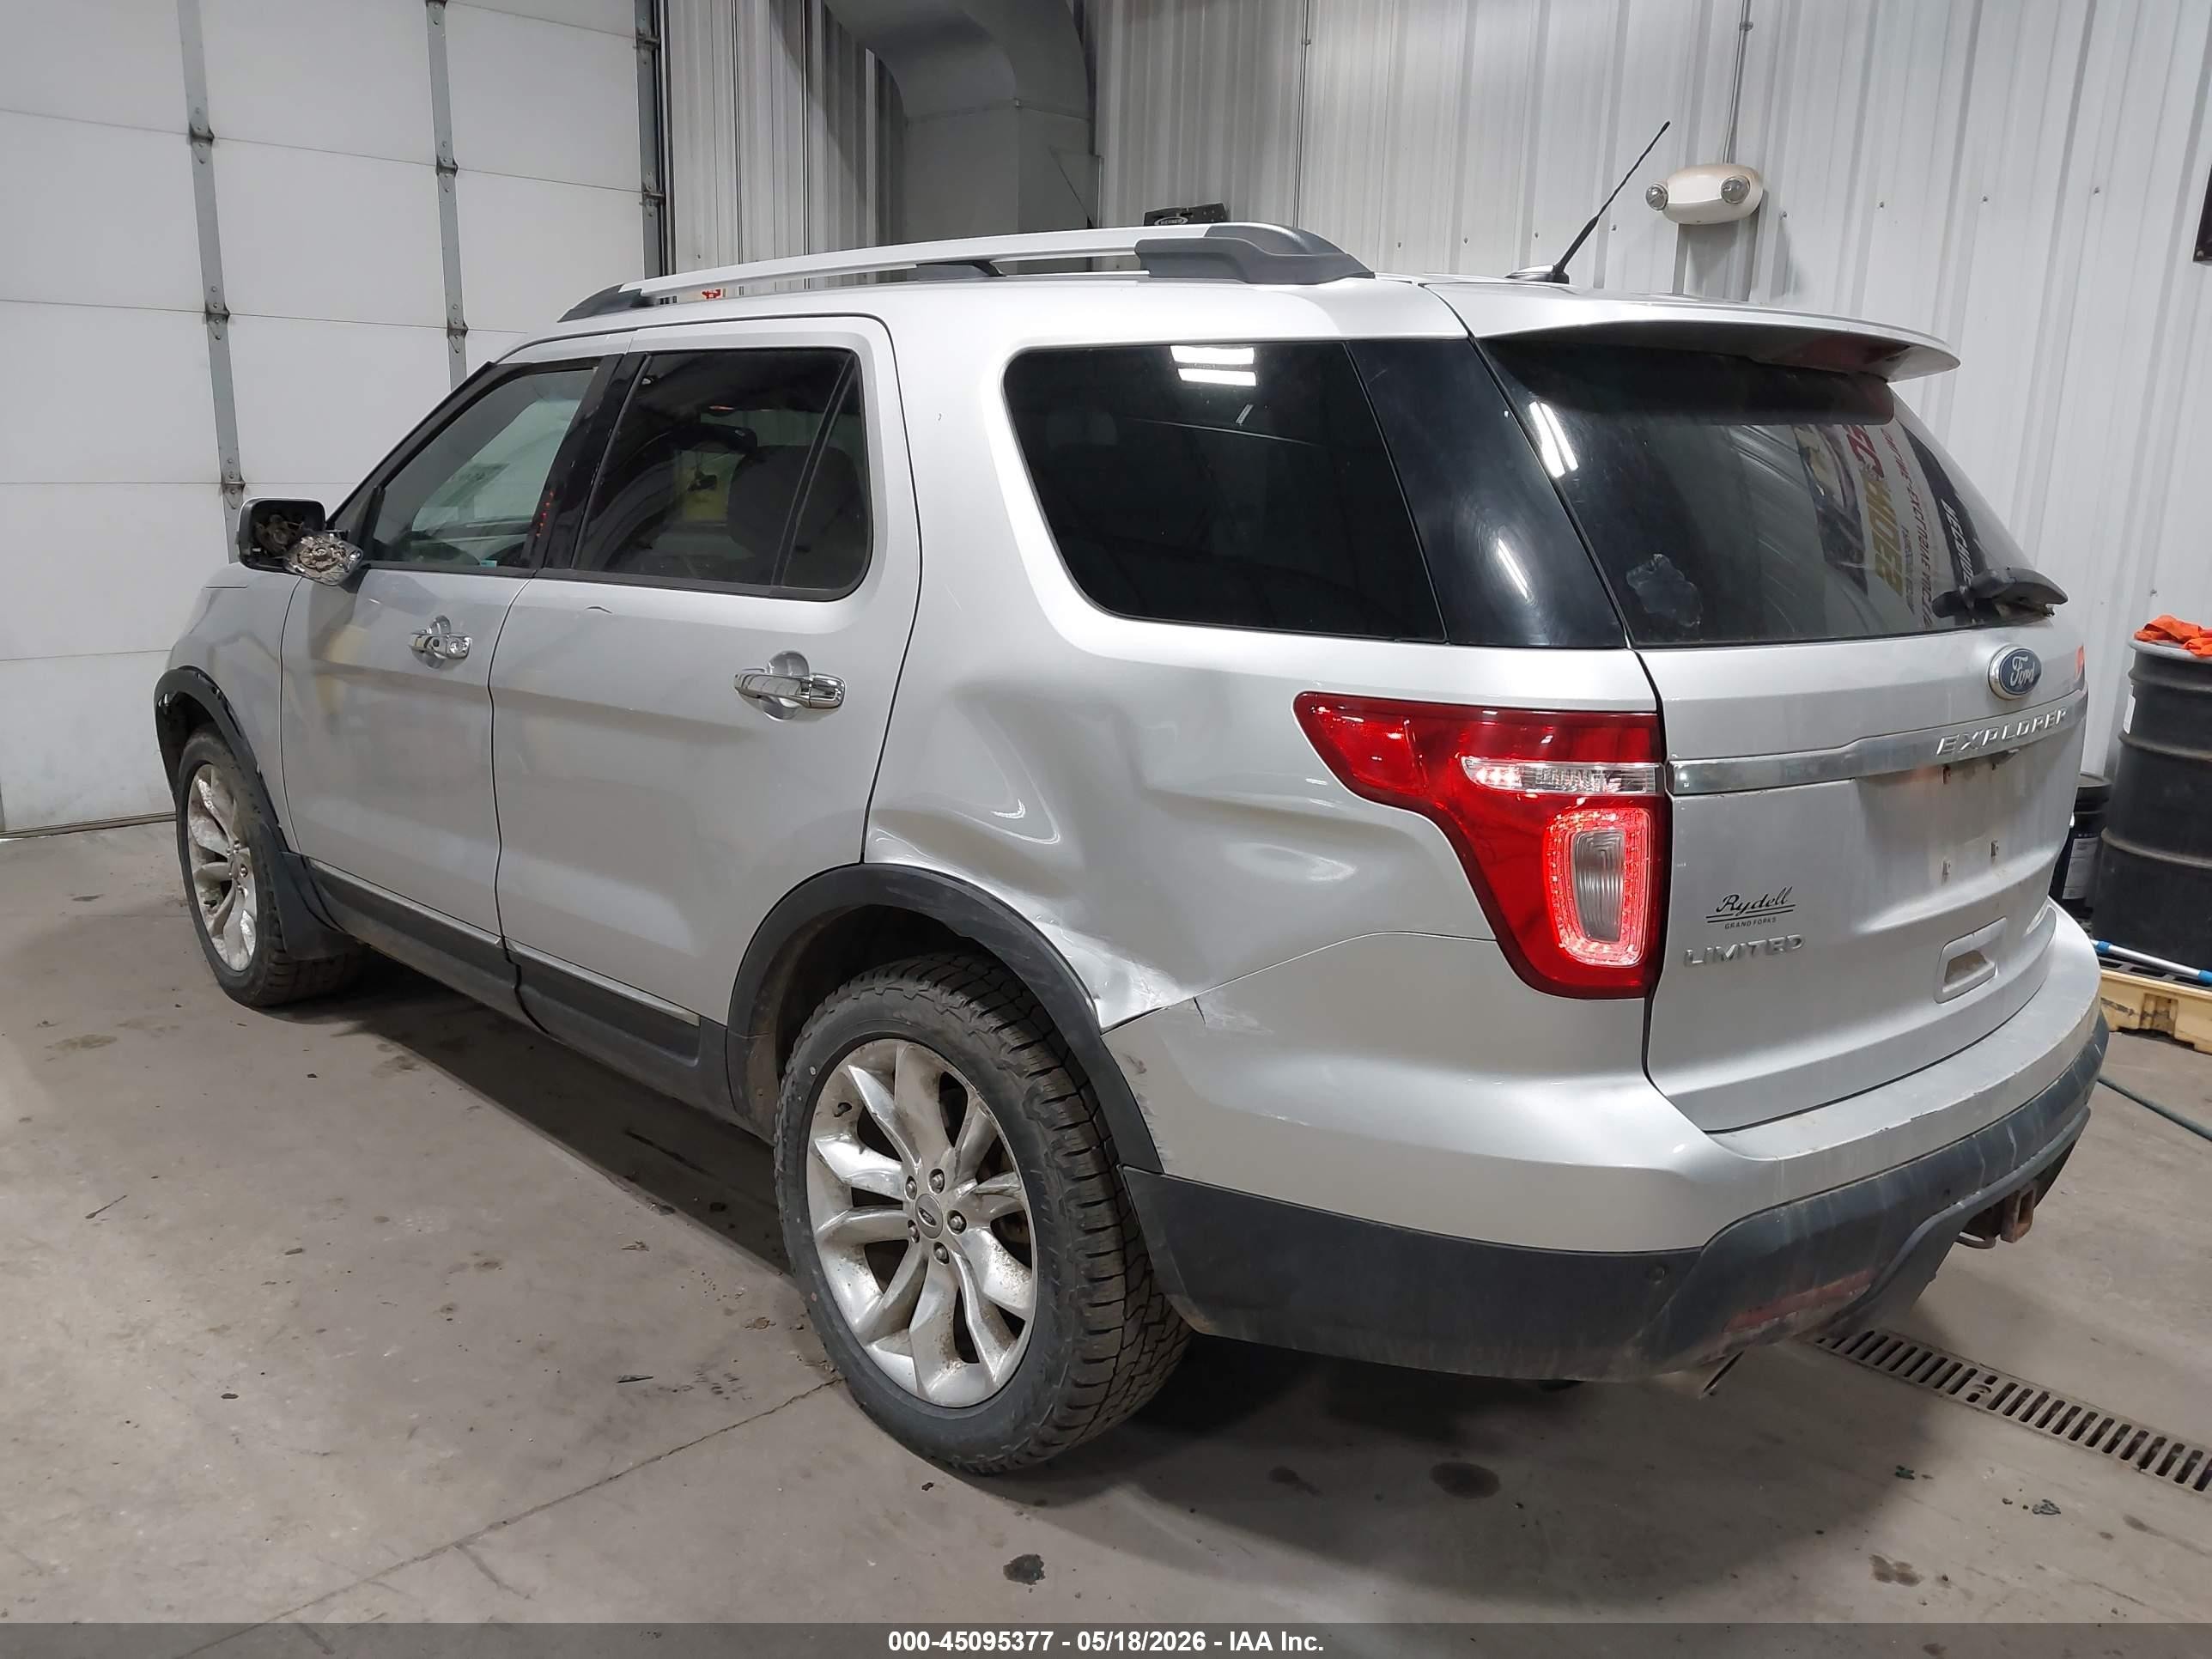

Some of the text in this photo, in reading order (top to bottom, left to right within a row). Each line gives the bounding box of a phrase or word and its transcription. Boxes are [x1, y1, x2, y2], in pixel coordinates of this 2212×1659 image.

[2009, 655, 2036, 687] Ford
[1936, 707, 2068, 756] EXPLORER
[1716, 886, 1793, 916] Rydell
[1724, 916, 1777, 930] GRAND FORKS
[1684, 934, 1803, 967] LIMITED
